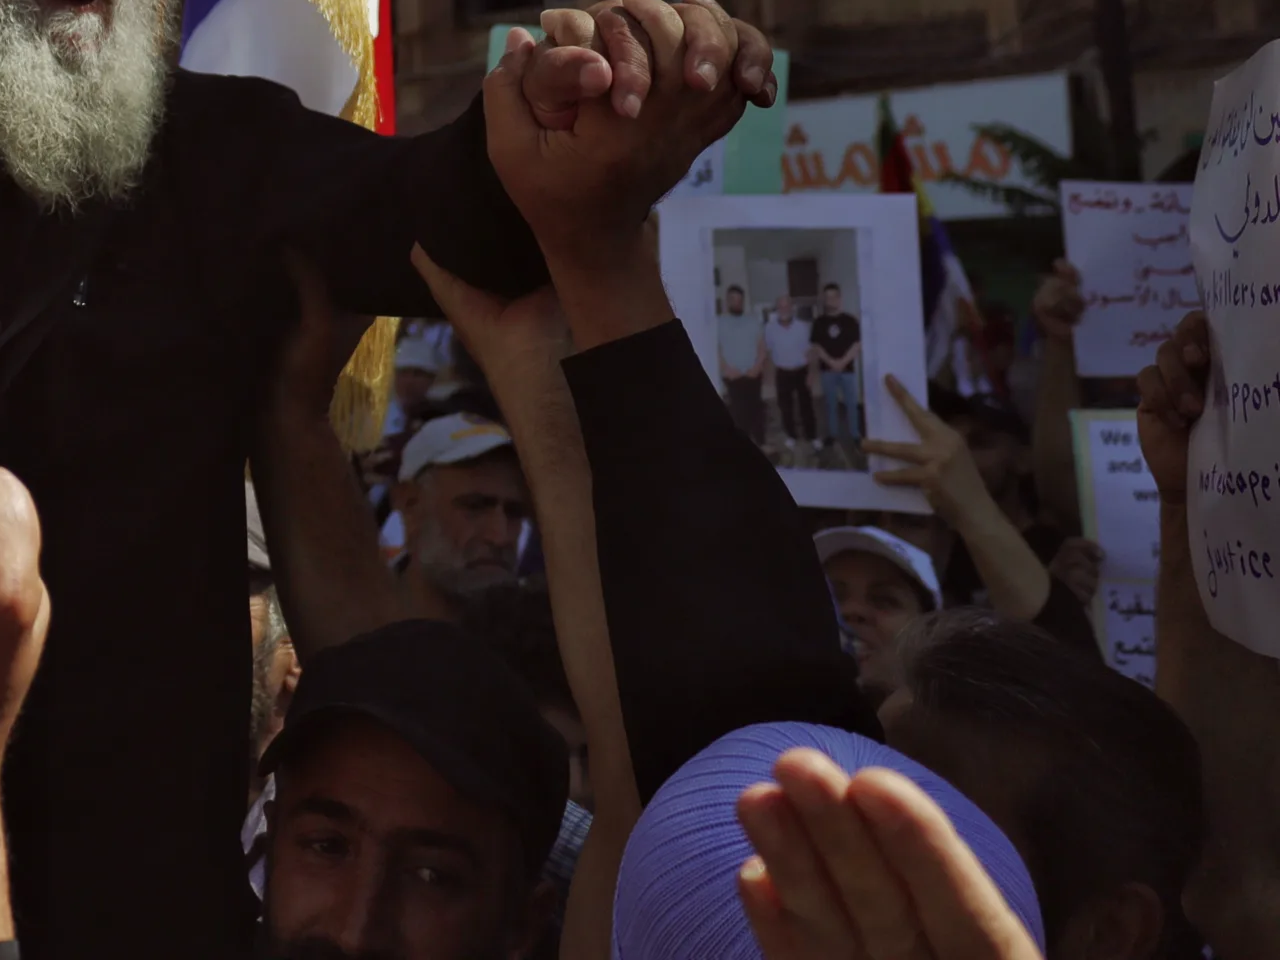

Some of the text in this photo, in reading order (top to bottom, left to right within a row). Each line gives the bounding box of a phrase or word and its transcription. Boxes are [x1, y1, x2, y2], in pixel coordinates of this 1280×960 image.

[1212, 267, 1255, 311] killers
[1230, 371, 1280, 423] pport
[1100, 429, 1132, 446] We
[1107, 458, 1142, 474] and
[1203, 528, 1274, 598] justice
